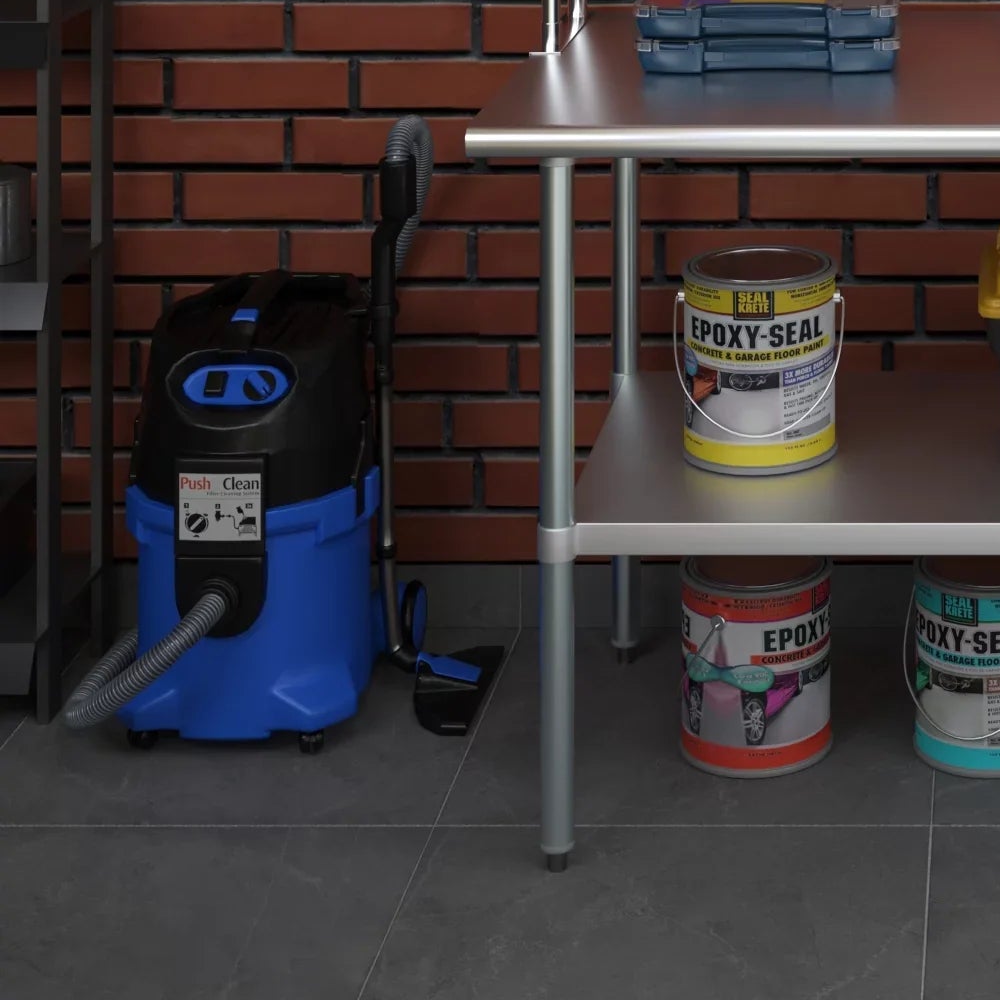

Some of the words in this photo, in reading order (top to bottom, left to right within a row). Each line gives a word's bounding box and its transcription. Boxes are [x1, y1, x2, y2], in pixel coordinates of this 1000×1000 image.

[738, 292, 769, 304] SEAL
[738, 304, 770, 314] KRETE
[692, 315, 823, 349] EPOXY-SEAL
[690, 342, 723, 359] CONCRETE
[725, 352, 732, 360] &
[735, 353, 771, 361] GARAGE
[774, 350, 800, 360] FLOOR
[803, 338, 824, 352] PAINT
[784, 370, 794, 379] 3X
[794, 366, 812, 376] MORE
[180, 476, 211, 490] Push
[222, 476, 260, 490] Clean
[945, 594, 974, 608] SEAL
[945, 606, 974, 620] KRETE
[762, 651, 804, 664] CONCRETE
[936, 651, 942, 659] &
[943, 652, 976, 666] GARAGE
